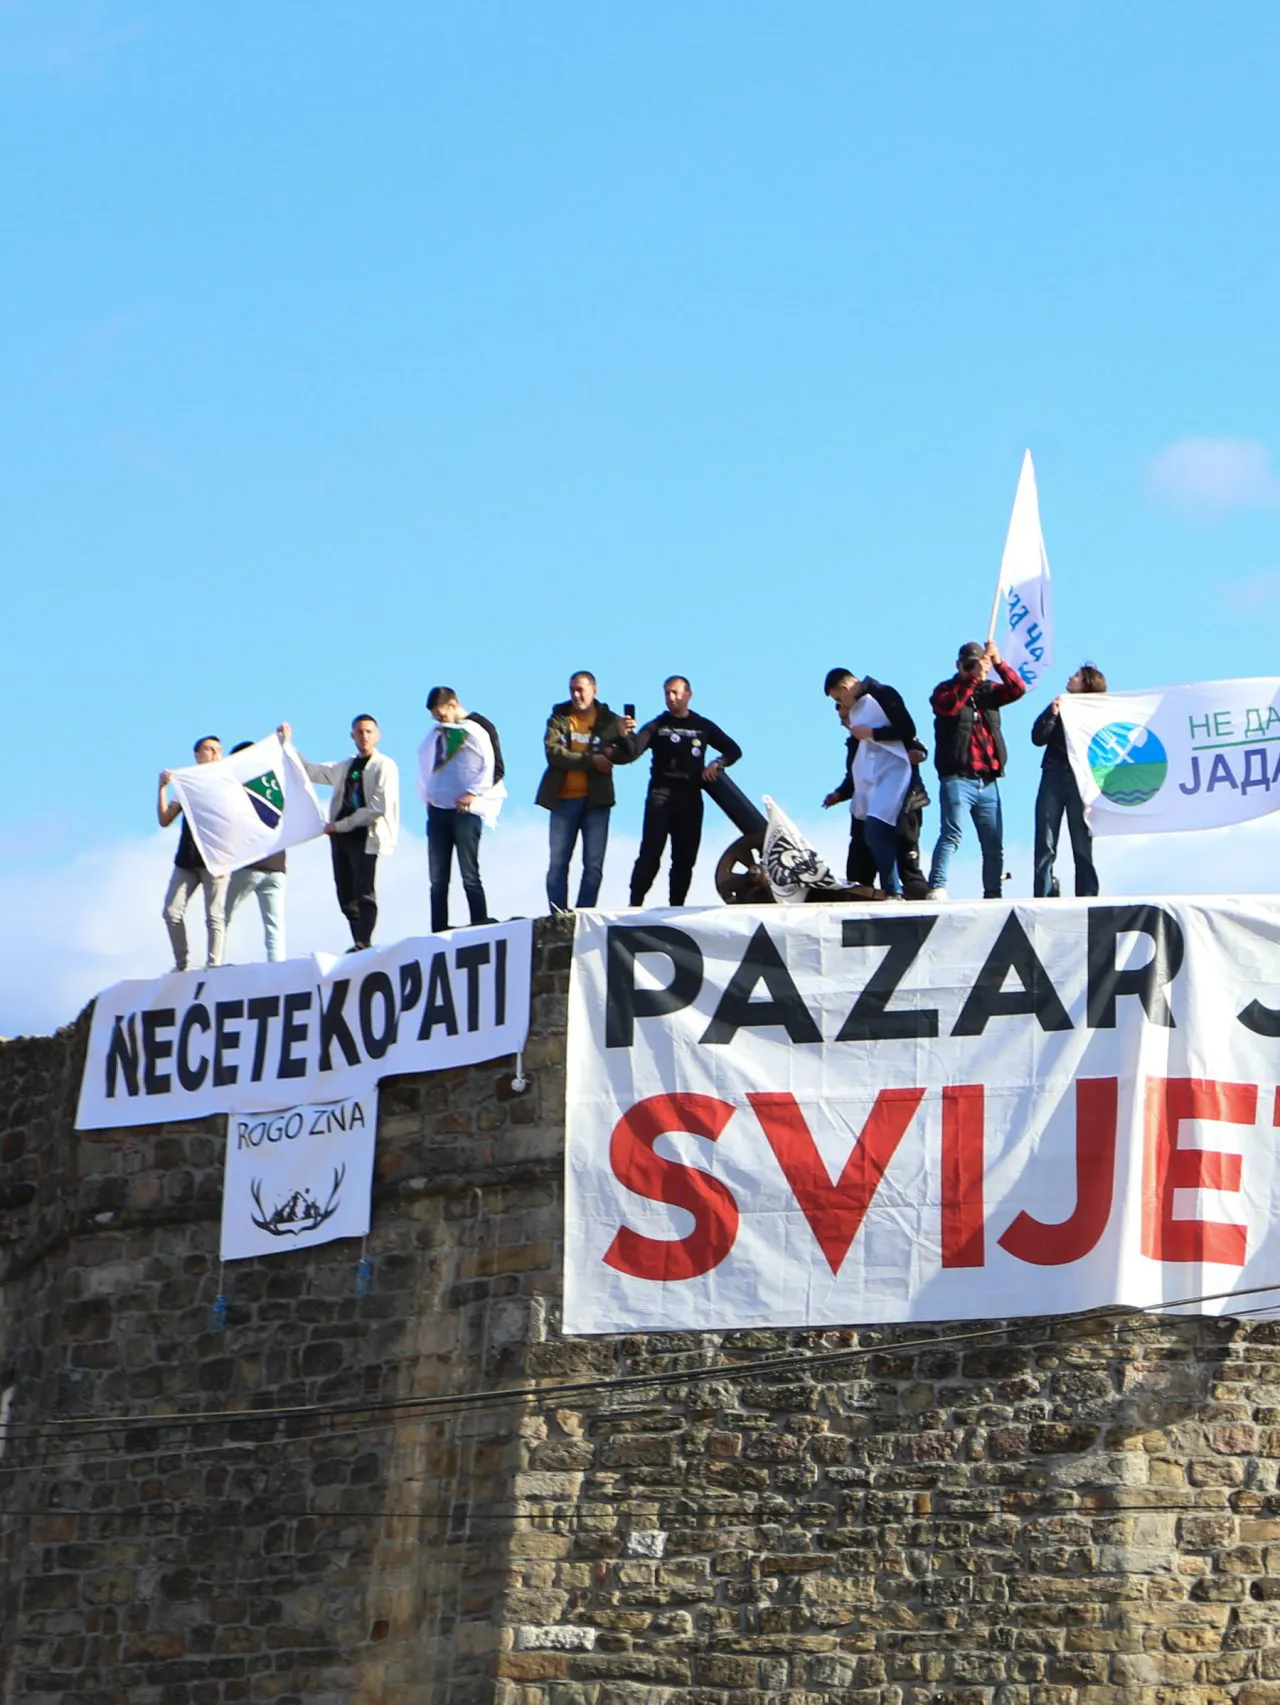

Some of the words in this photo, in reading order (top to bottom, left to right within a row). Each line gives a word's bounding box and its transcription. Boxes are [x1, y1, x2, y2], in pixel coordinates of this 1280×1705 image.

[1188, 710, 1235, 740] НЕ
[105, 981, 313, 1098] NEĆETE
[317, 938, 508, 1072] KOPATI
[605, 905, 1186, 1048] PAZAR
